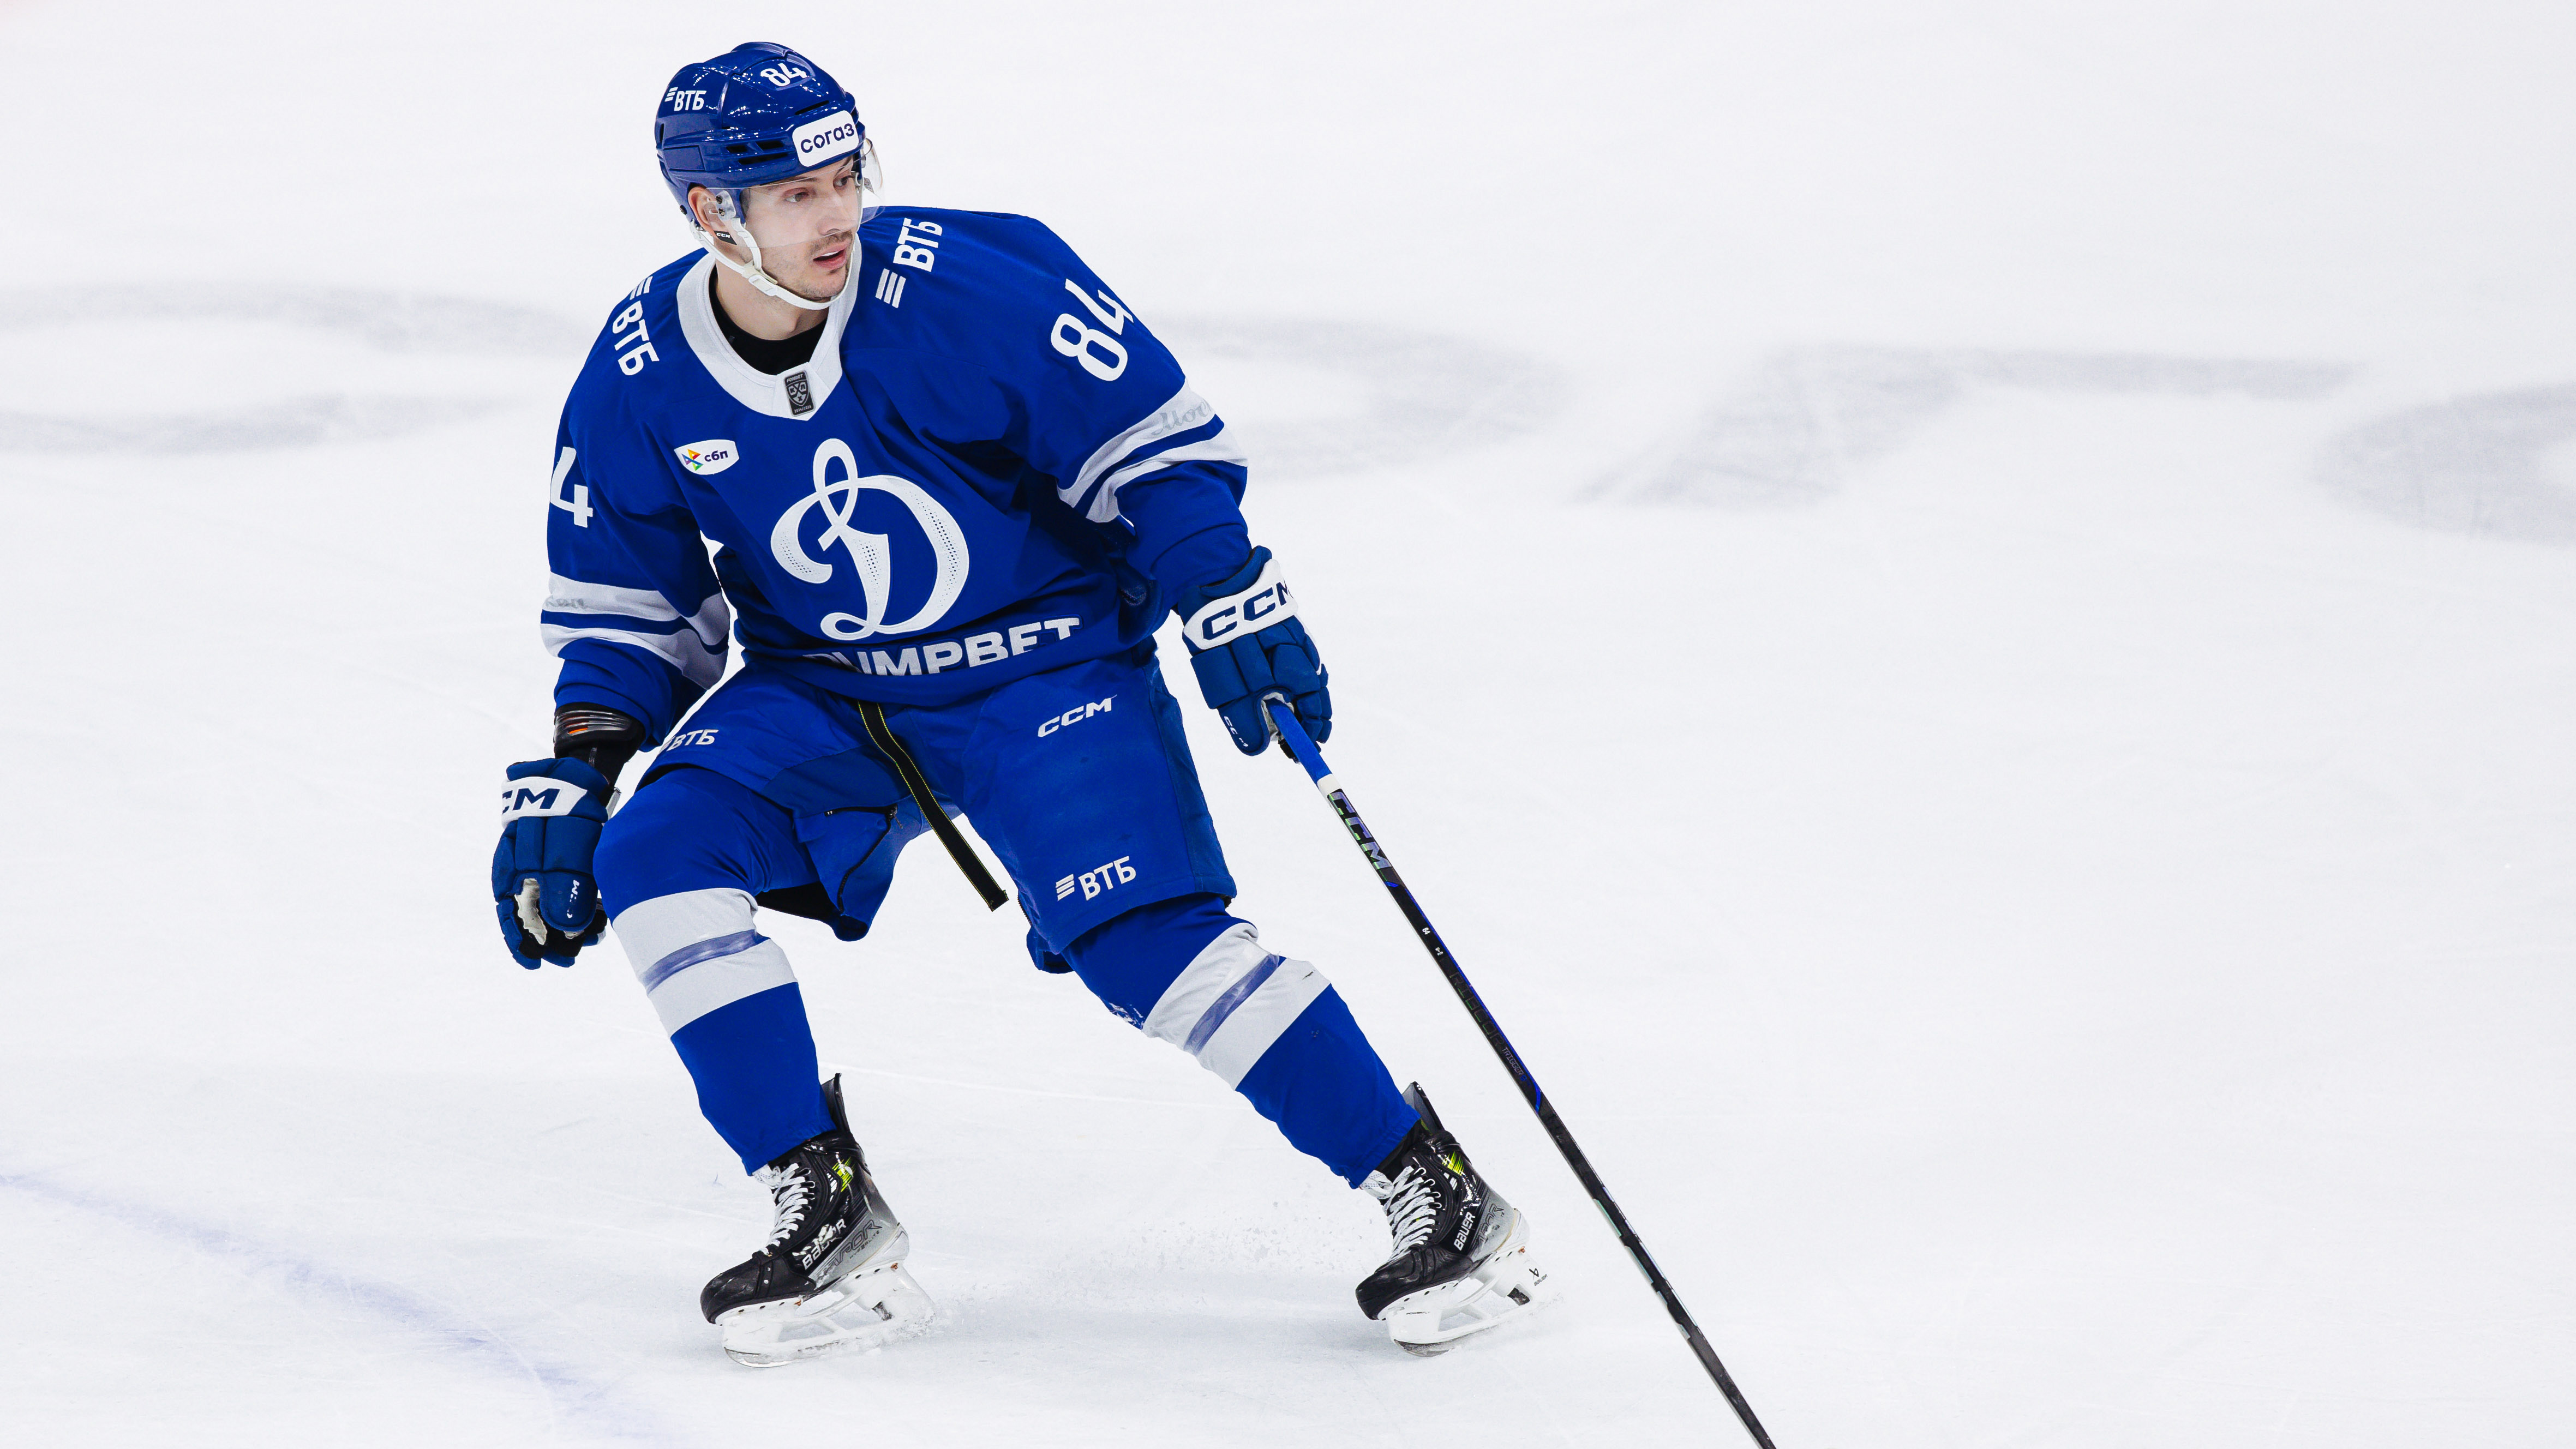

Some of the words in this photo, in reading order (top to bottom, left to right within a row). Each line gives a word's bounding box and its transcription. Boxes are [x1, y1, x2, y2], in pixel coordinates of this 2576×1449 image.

[760, 63, 807, 87] 84
[674, 90, 706, 111] ВТБ
[892, 218, 943, 272] ВТБ
[612, 300, 660, 376] ВТБ
[1051, 278, 1134, 381] 84
[550, 446, 593, 528] 4
[666, 729, 719, 751] ВТБ
[1038, 696, 1113, 737] CCM
[1329, 791, 1392, 870] CCM
[1079, 856, 1136, 900] ВТБ
